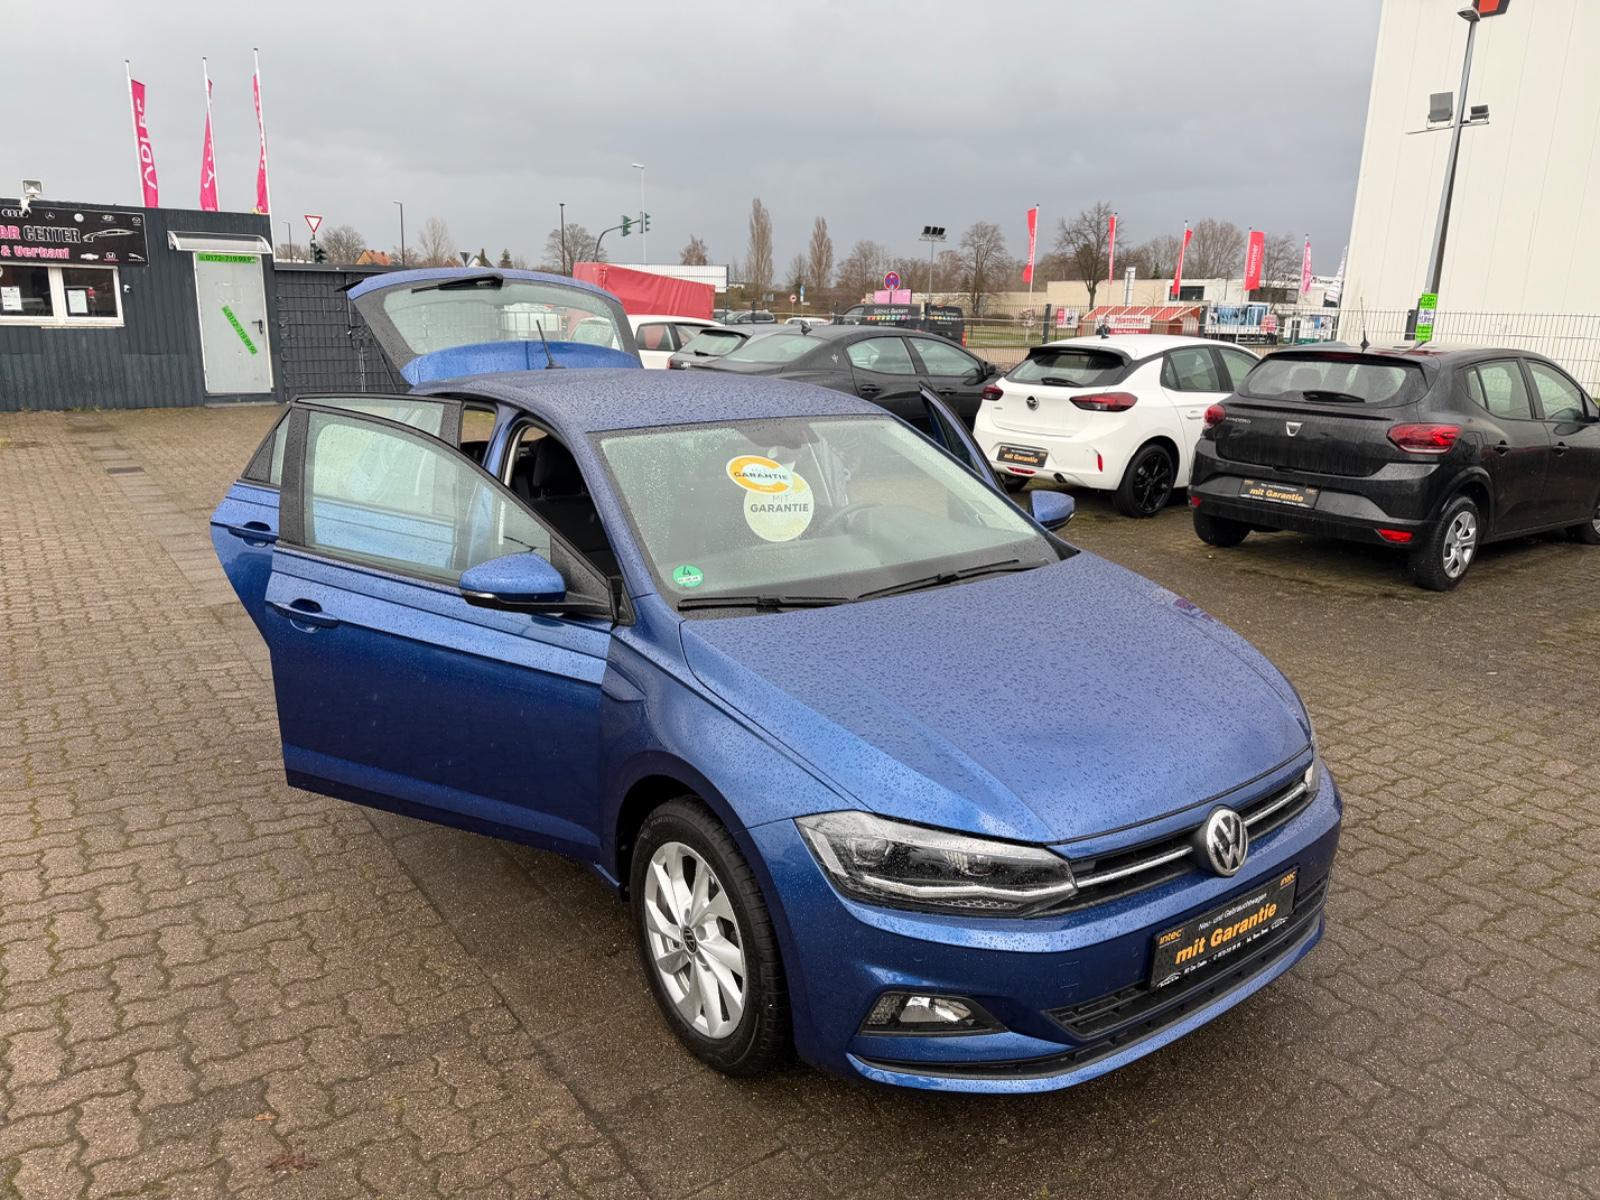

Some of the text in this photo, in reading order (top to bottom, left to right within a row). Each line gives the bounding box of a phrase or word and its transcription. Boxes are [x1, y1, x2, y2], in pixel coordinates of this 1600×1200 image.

[23, 225, 82, 243] CENTER
[1249, 488, 1265, 496] mit
[1266, 489, 1304, 503] Garantie
[750, 503, 809, 513] GARANTIE
[1175, 936, 1208, 966] mit
[1210, 902, 1278, 949] Garantie
